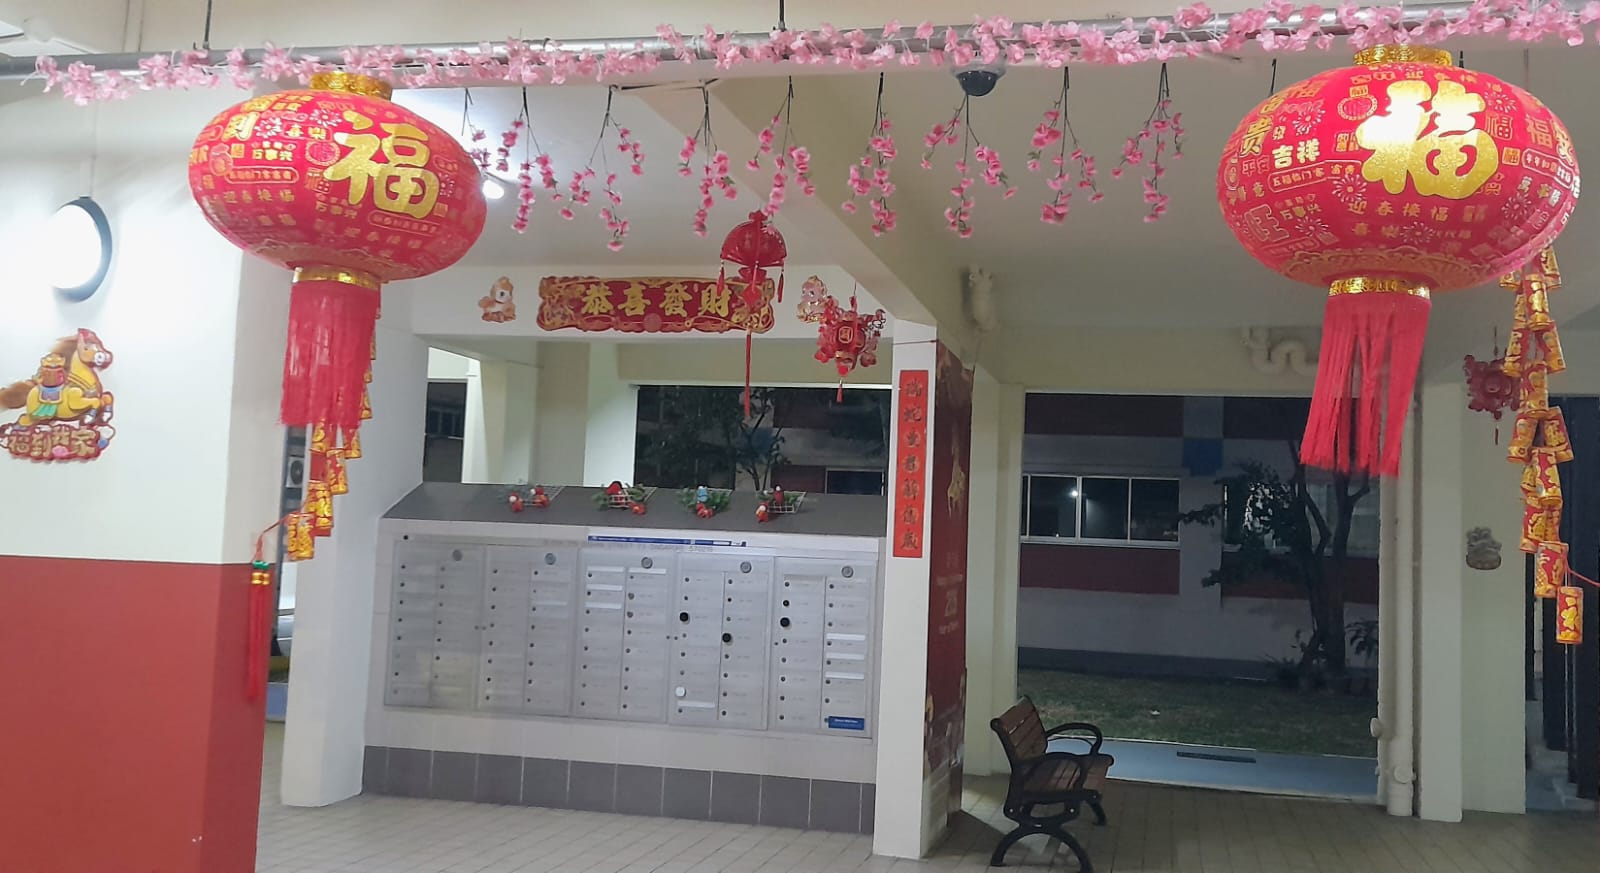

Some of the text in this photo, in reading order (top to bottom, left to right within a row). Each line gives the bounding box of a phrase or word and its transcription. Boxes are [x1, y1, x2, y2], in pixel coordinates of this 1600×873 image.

[1356, 80, 1499, 199] 福
[1525, 114, 1552, 148] 福
[324, 110, 439, 219] 福
[1272, 138, 1320, 169] 吉祥
[1348, 200, 1449, 221] 迎春接福
[582, 283, 731, 317] 恭喜發財
